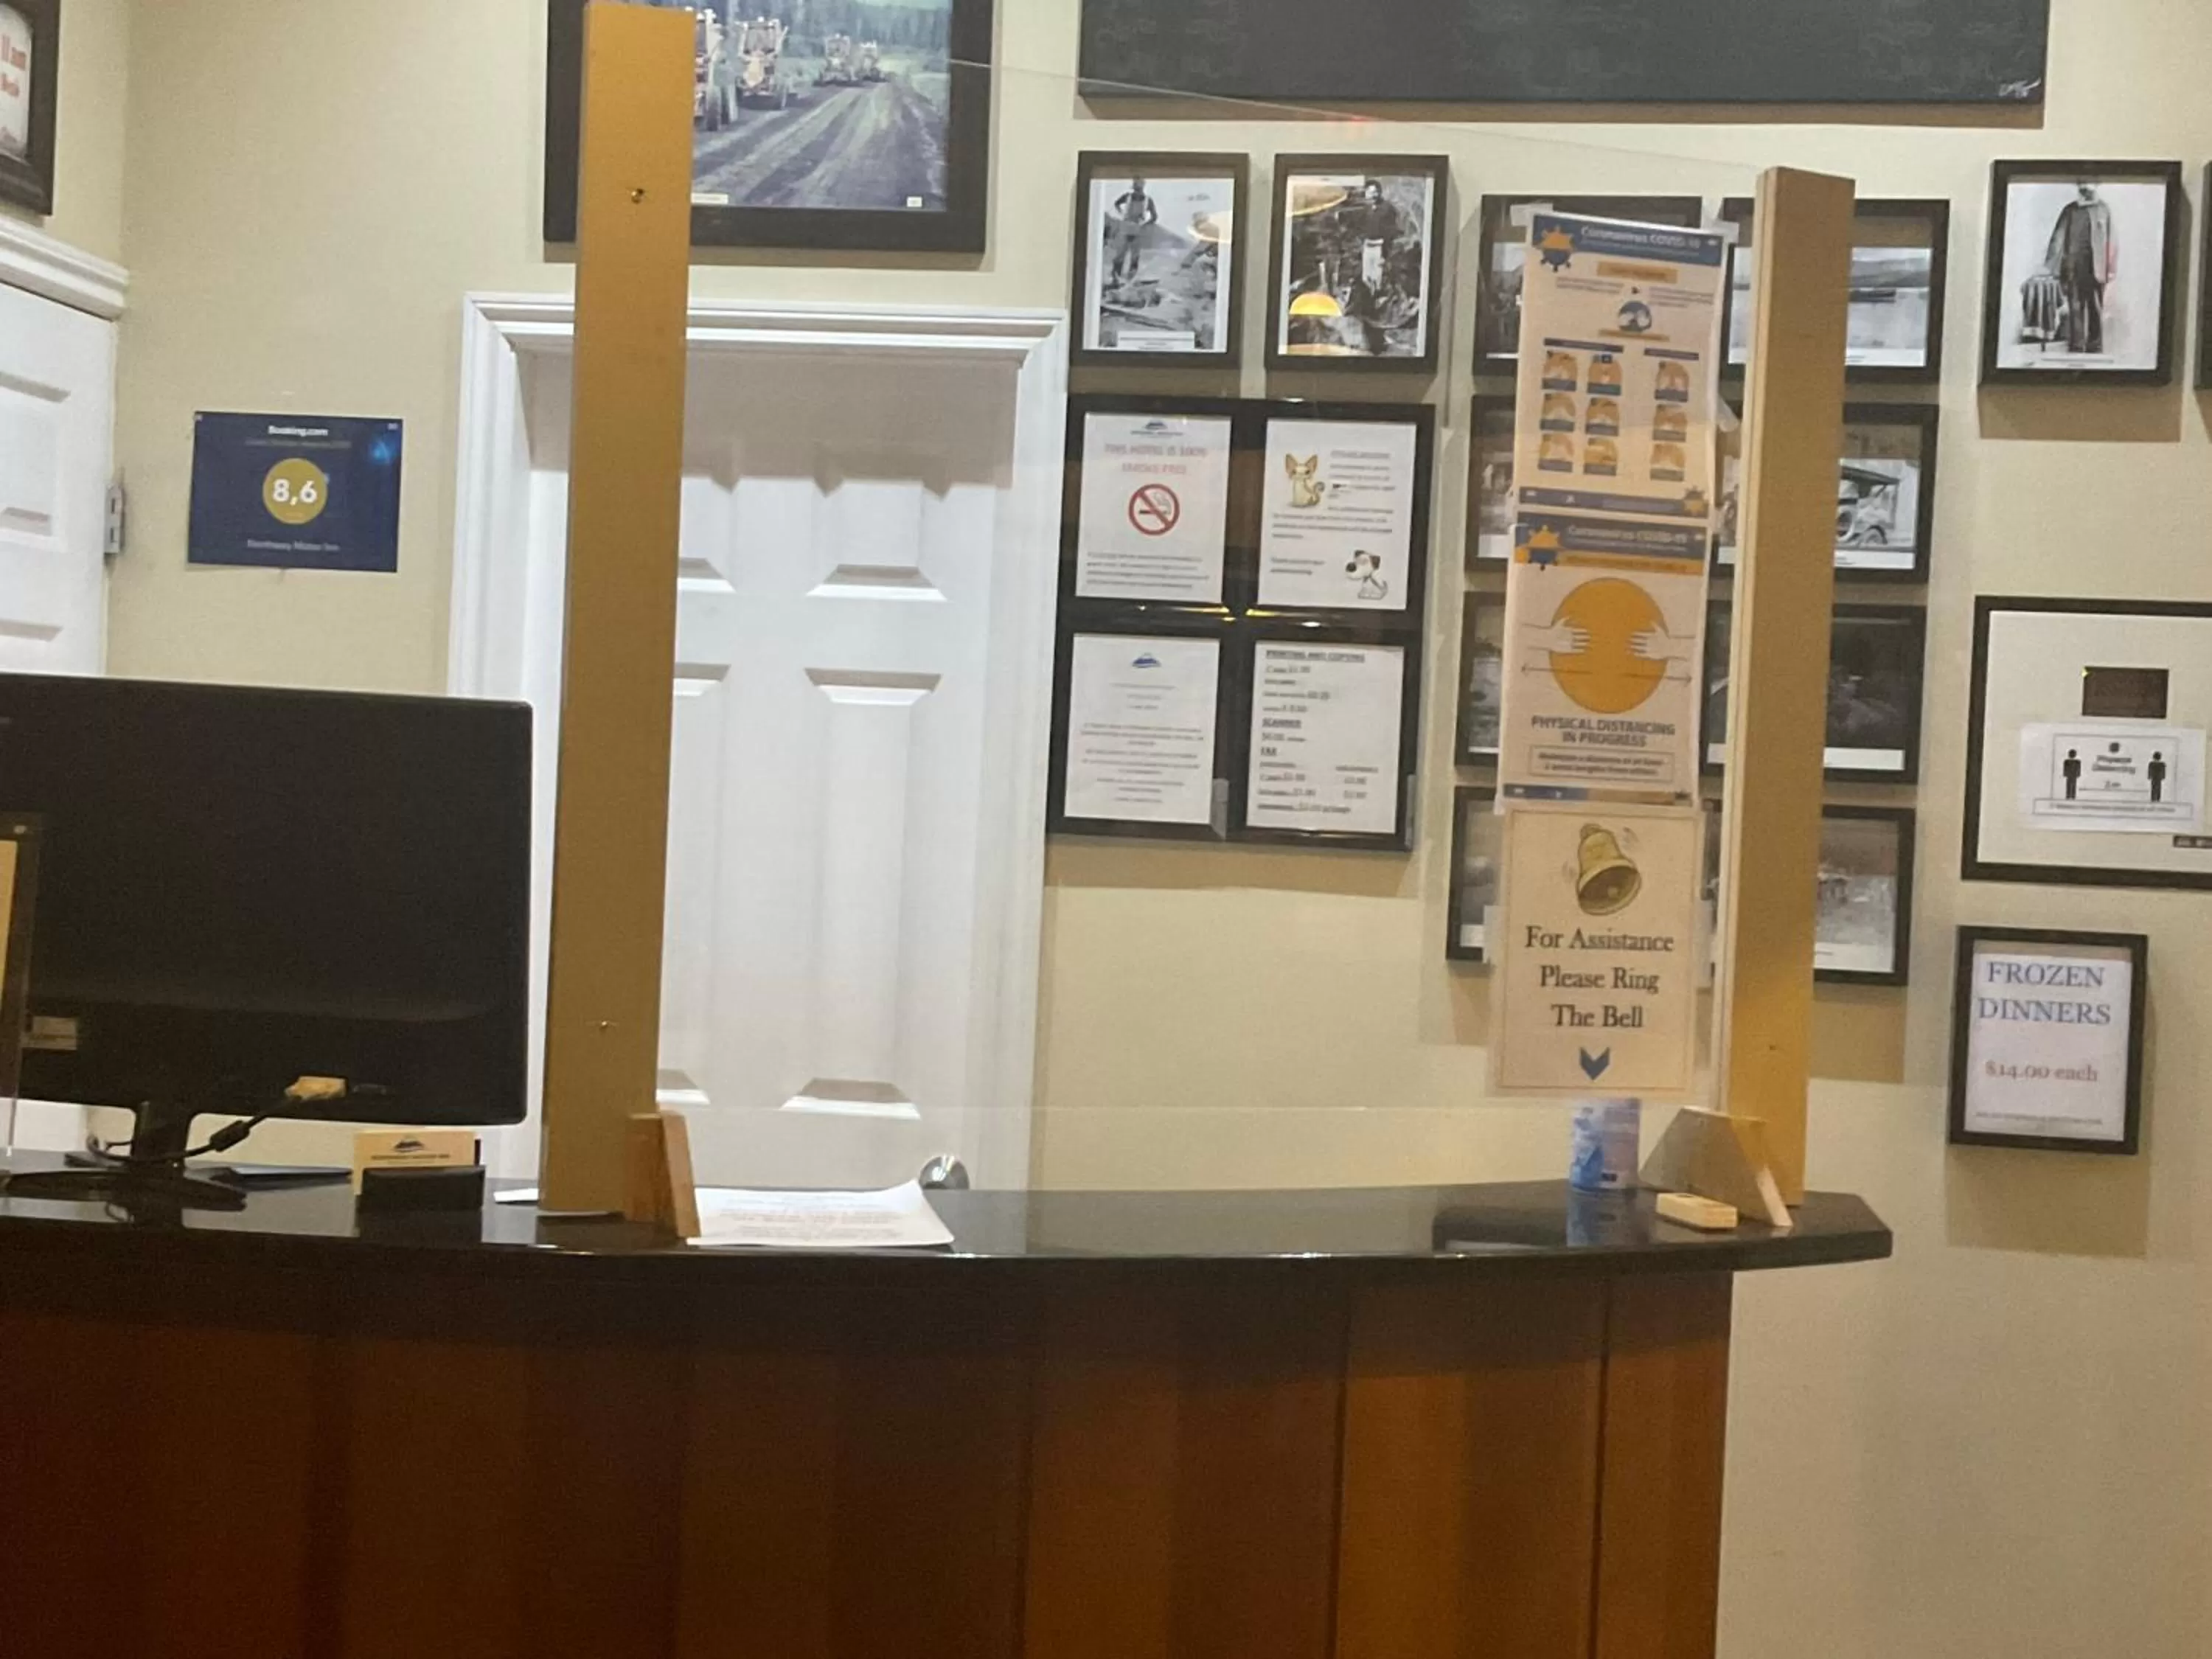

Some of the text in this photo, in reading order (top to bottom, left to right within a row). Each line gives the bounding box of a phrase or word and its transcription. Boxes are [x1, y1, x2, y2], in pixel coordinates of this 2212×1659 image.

[273, 479, 318, 506] 8,6
[1531, 715, 1676, 736] PHYSICAL DISTANCING
[1579, 731, 1647, 747] PROGRESS
[1525, 925, 1674, 952] For Assistance
[1540, 964, 1660, 995] Please Ring
[1986, 961, 2105, 988] FROZEN
[1551, 1004, 1644, 1028] The Bell
[1978, 996, 2112, 1025] DINNERS
[1985, 1060, 2098, 1082] $14.00 each
